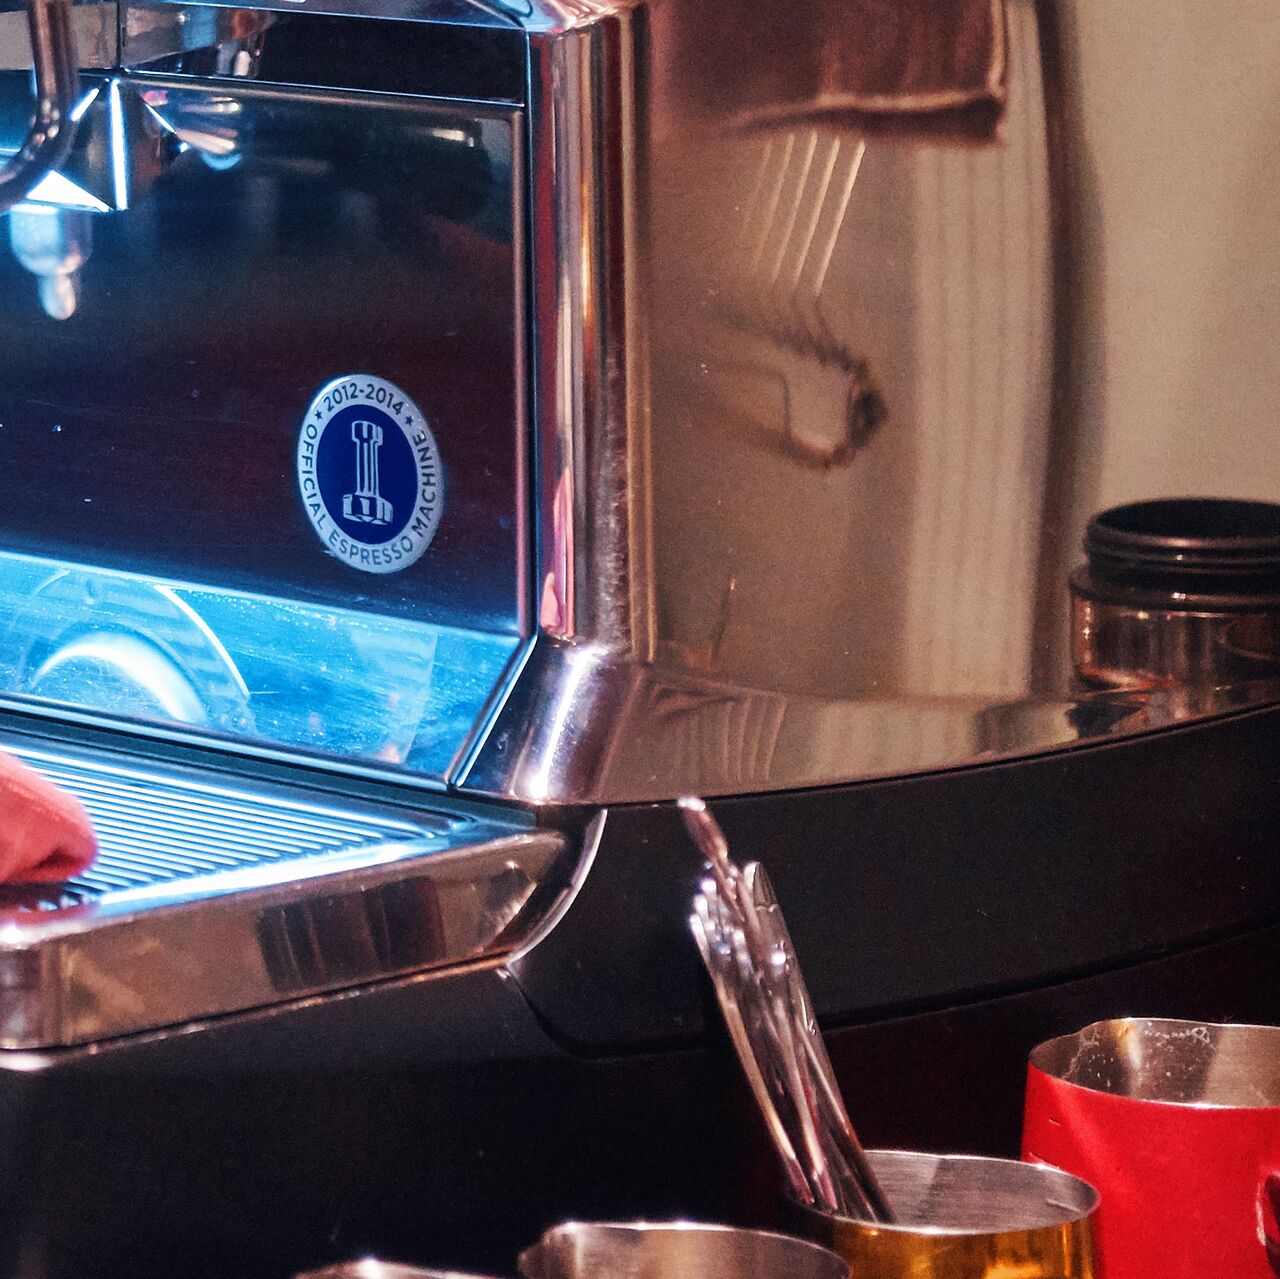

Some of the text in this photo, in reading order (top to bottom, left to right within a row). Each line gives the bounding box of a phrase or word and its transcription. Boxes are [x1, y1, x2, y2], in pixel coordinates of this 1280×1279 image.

[323, 382, 405, 416] 2012-2014
[301, 423, 438, 566] OFFICIAL ESPRESSO MACHINE
